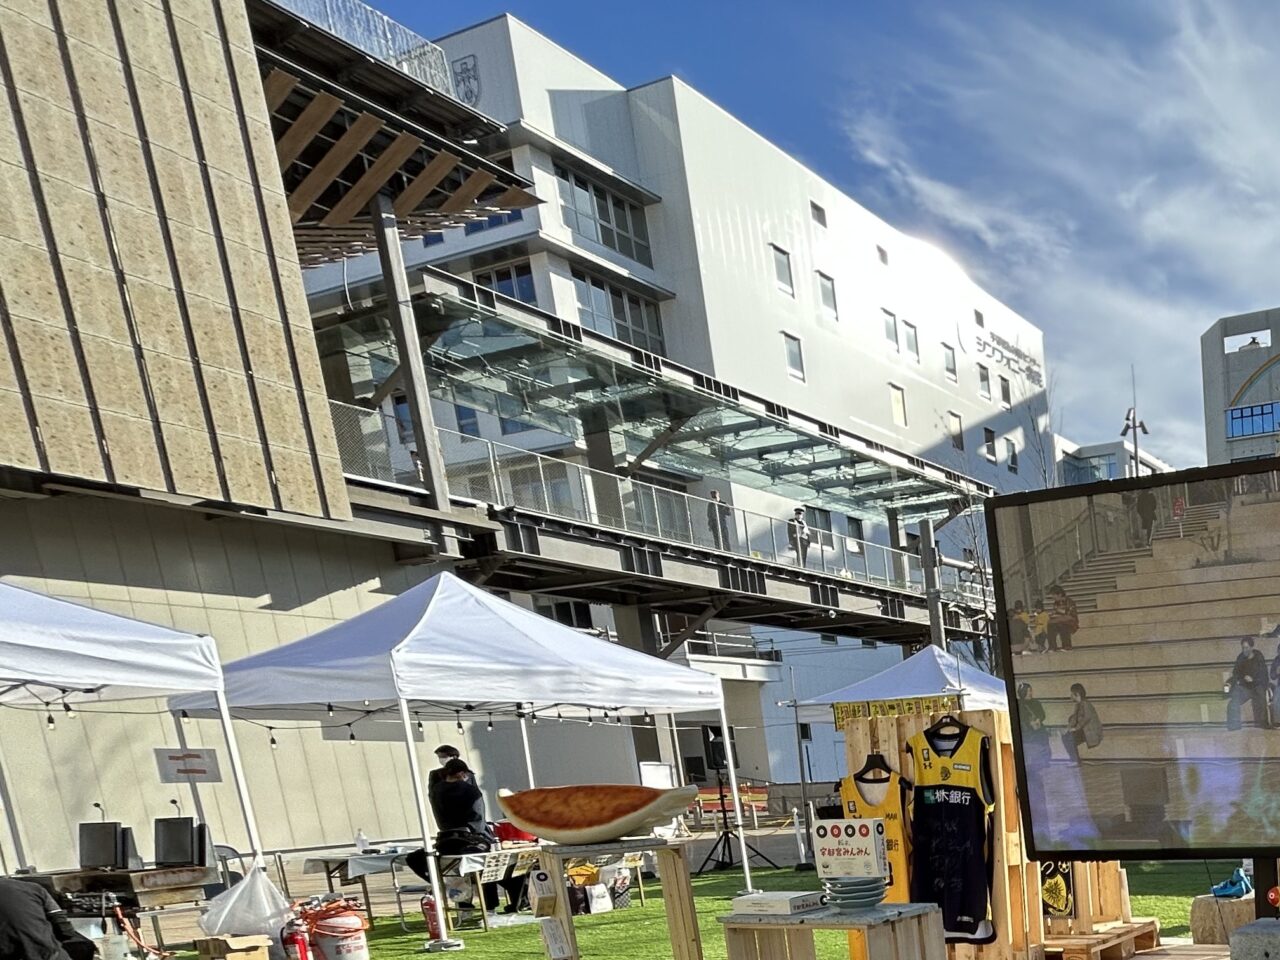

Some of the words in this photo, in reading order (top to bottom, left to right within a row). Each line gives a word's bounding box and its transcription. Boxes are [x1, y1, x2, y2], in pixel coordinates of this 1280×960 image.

[820, 846, 871, 857] 宇都宮みんみん
